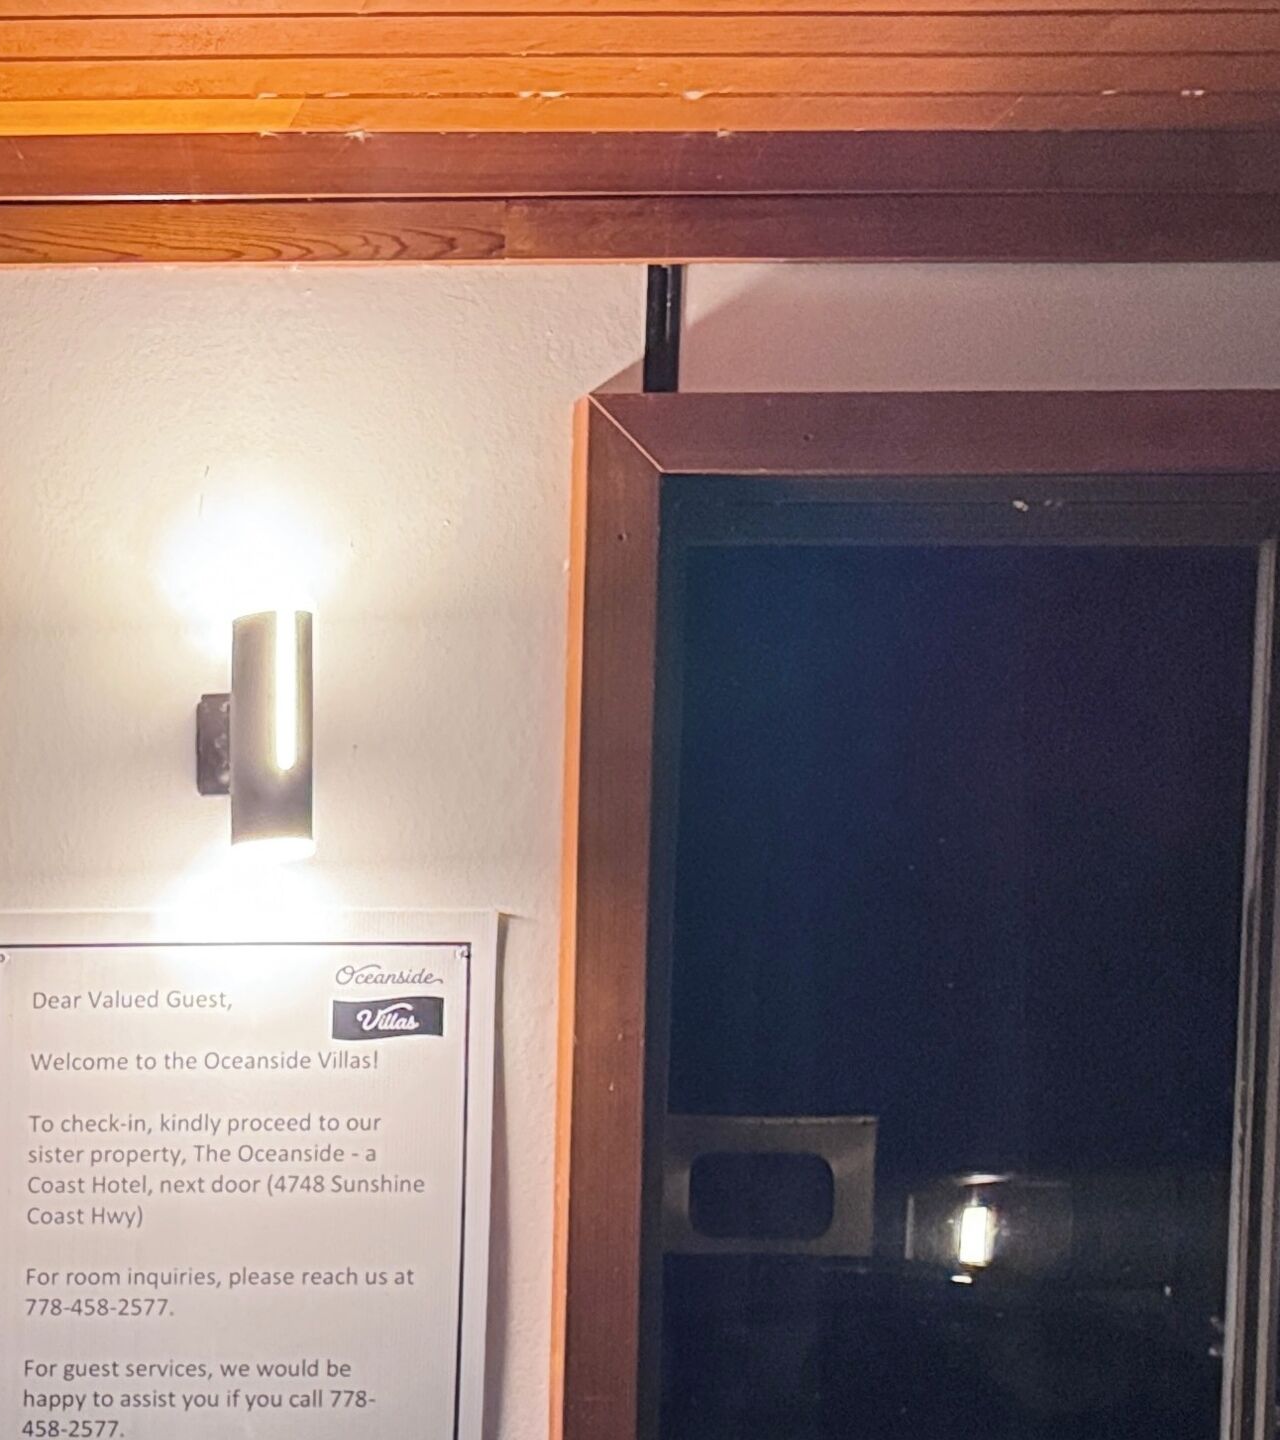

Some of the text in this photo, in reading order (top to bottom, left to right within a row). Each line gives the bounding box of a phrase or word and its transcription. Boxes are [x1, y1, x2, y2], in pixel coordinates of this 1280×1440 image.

[335, 964, 444, 985] Oceanside
[32, 989, 233, 1011] Dear Valued Guest,
[356, 1002, 420, 1031] Villas
[30, 1050, 378, 1071] Welcome to the Oceanside Villas!
[28, 1112, 382, 1137] To check-in, kindly proceed to our
[28, 1144, 85, 1164] sister
[90, 1146, 187, 1168] property,
[192, 1143, 232, 1163] The
[237, 1143, 345, 1163] Oceanside
[365, 1148, 377, 1162] a
[27, 1173, 425, 1198] Coast Hotel, next door (4748 Sunshine
[26, 1205, 143, 1229] Coast Hwy)
[26, 1266, 415, 1290] For room inquiries, please reach us at
[25, 1297, 174, 1317] 778-458-2577.
[24, 1358, 352, 1382] For guest services, we would be
[22, 1388, 376, 1413] happy to assist you if you call 778-
[21, 1419, 125, 1439] 458-2577.
